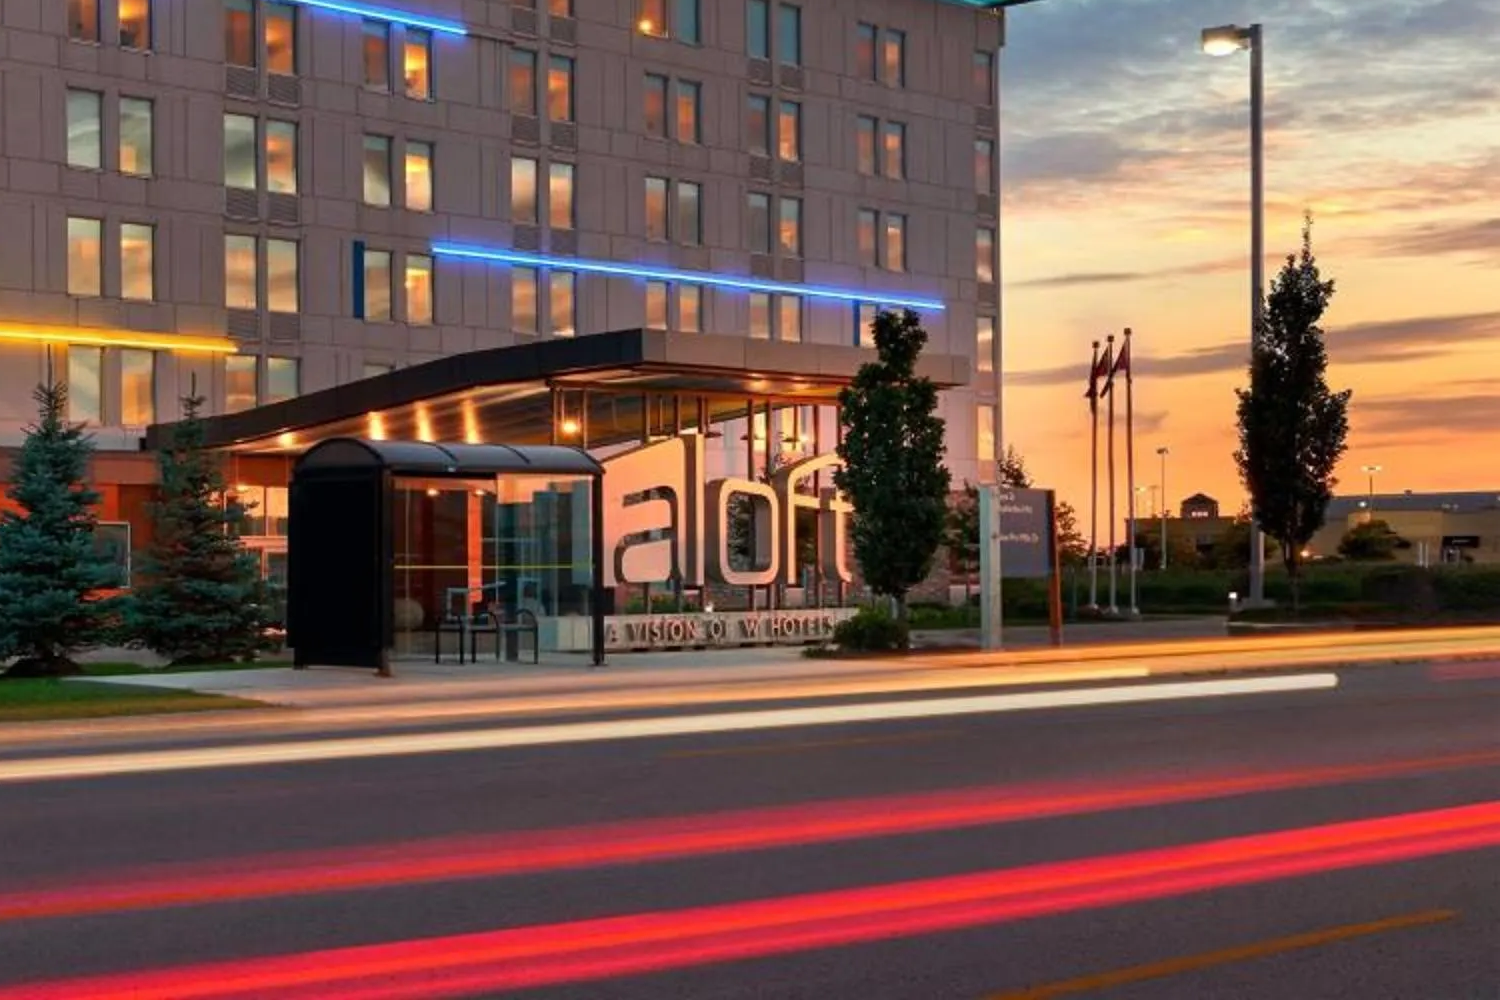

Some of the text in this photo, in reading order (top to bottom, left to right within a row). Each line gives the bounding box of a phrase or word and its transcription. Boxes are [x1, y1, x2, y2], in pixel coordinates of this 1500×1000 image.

[601, 433, 855, 590] aloft
[626, 618, 704, 643] VISION
[767, 614, 835, 638] HOTELS
